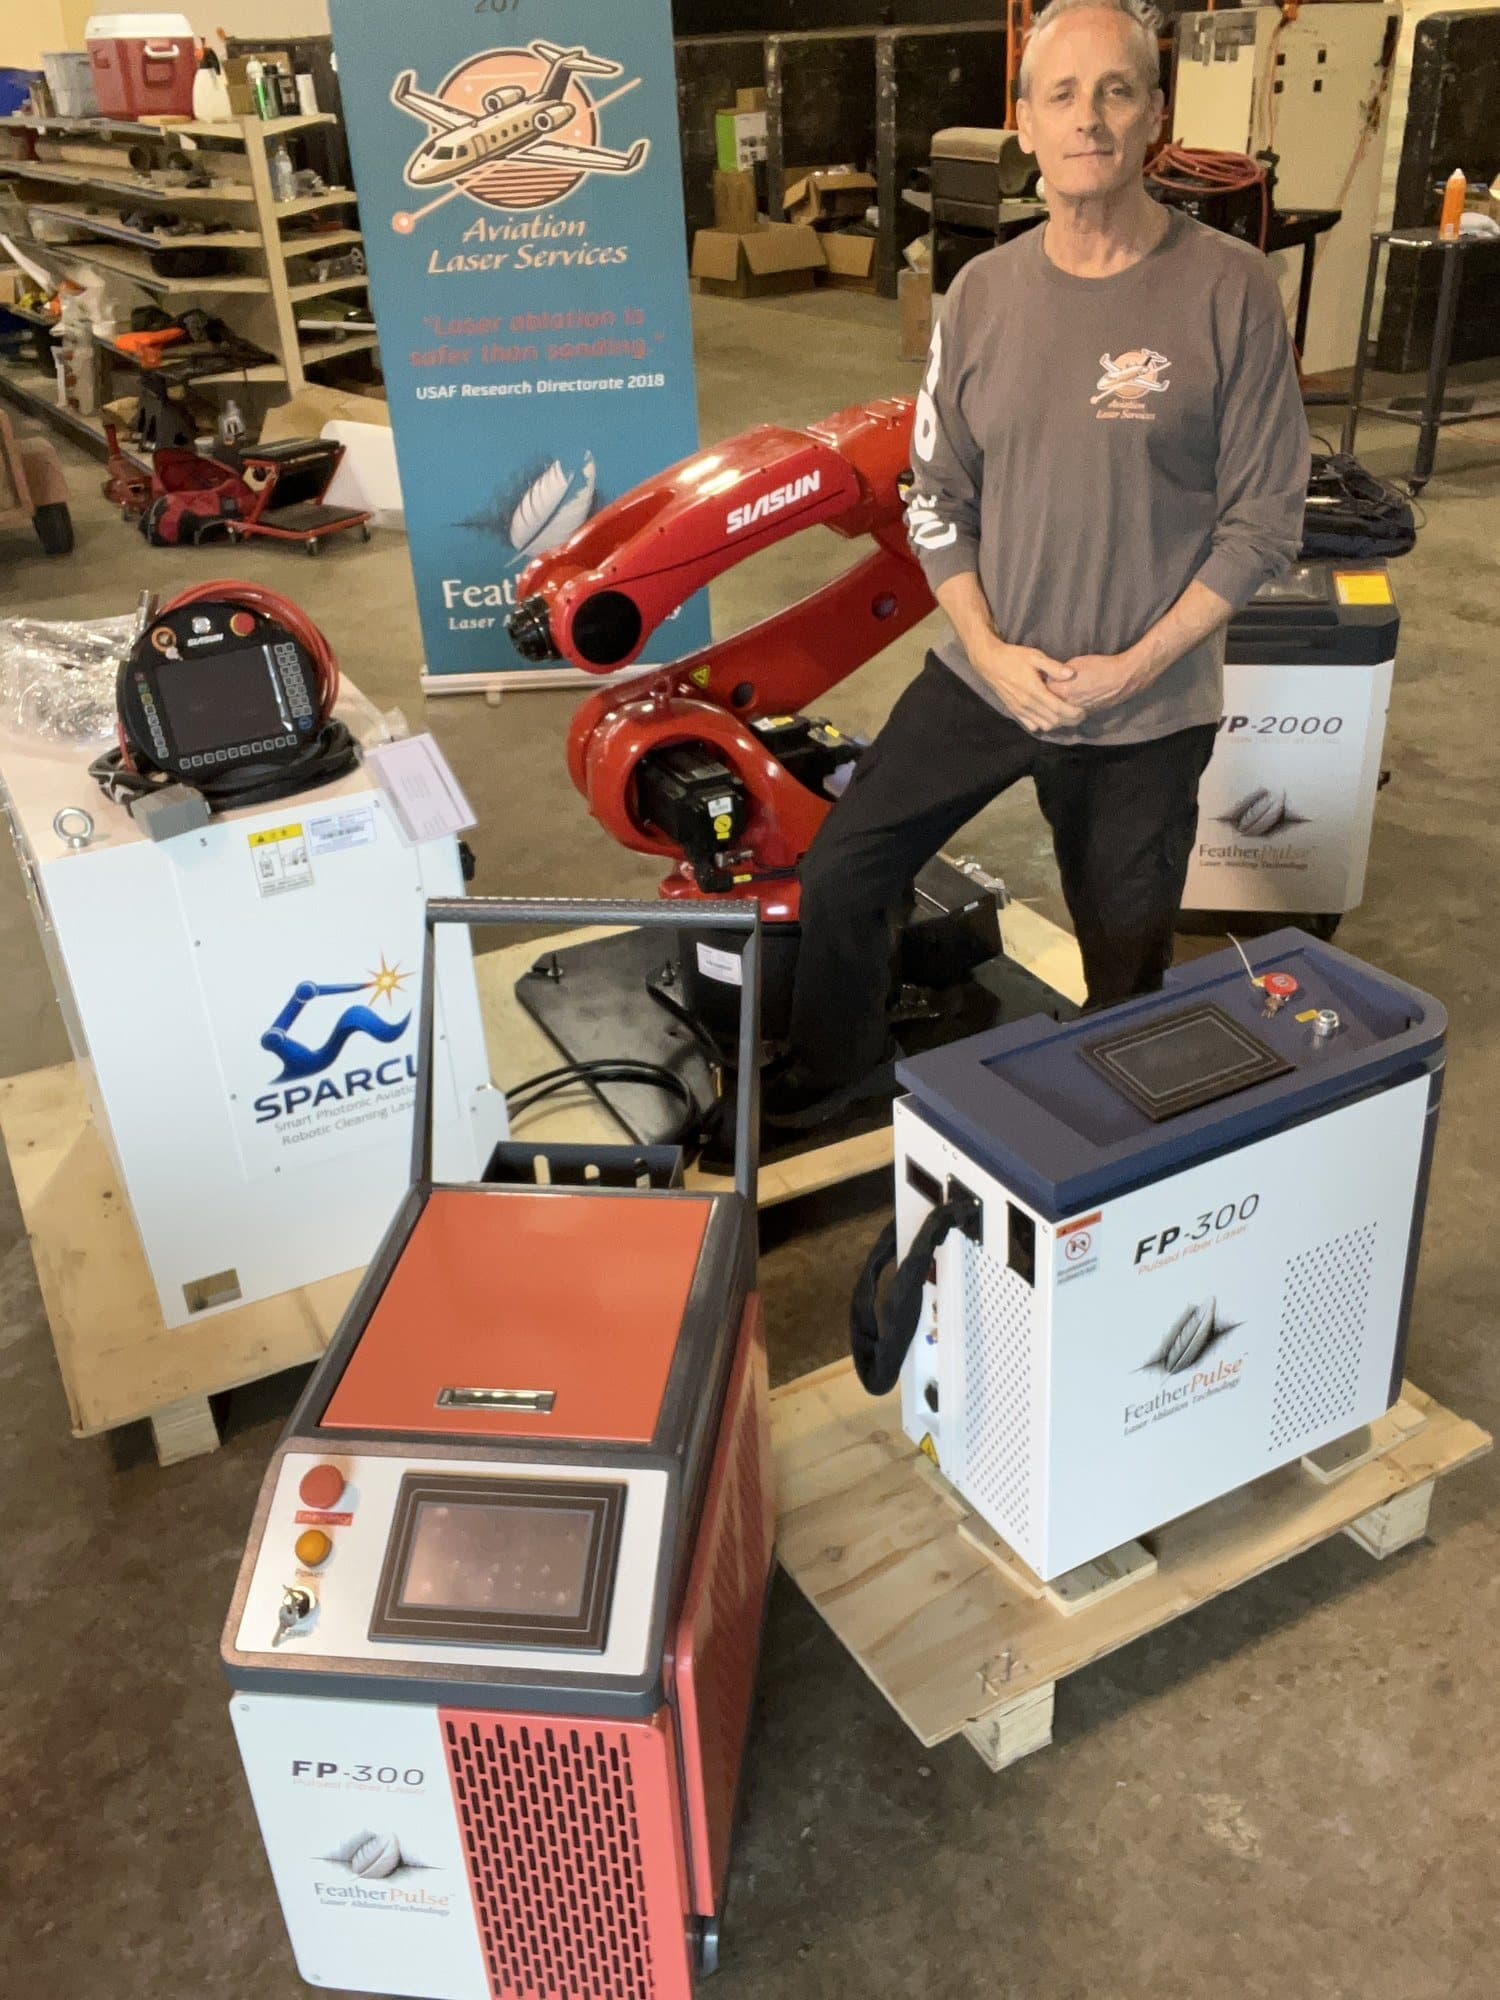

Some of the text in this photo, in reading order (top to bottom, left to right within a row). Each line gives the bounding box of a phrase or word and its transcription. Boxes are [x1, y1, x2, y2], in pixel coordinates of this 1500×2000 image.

[462, 213, 587, 243] Aviation
[427, 241, 628, 274] Laser Services
[509, 310, 616, 333] ablation
[624, 307, 645, 327] is
[410, 345, 470, 368] safer
[481, 343, 539, 364] than
[416, 373, 666, 400] USAF Research Directorate 2018
[726, 469, 821, 534] SIASUN
[442, 573, 520, 609] Feat
[449, 617, 497, 631] Laser
[1218, 715, 1344, 735] P-2000
[274, 1114, 312, 1134] Smart
[316, 1098, 372, 1121] Photonic
[281, 1125, 332, 1146] Robotic
[334, 1107, 389, 1131] Cleaning
[1134, 1193, 1260, 1265] FP-300
[292, 1760, 425, 1786] FP-300
